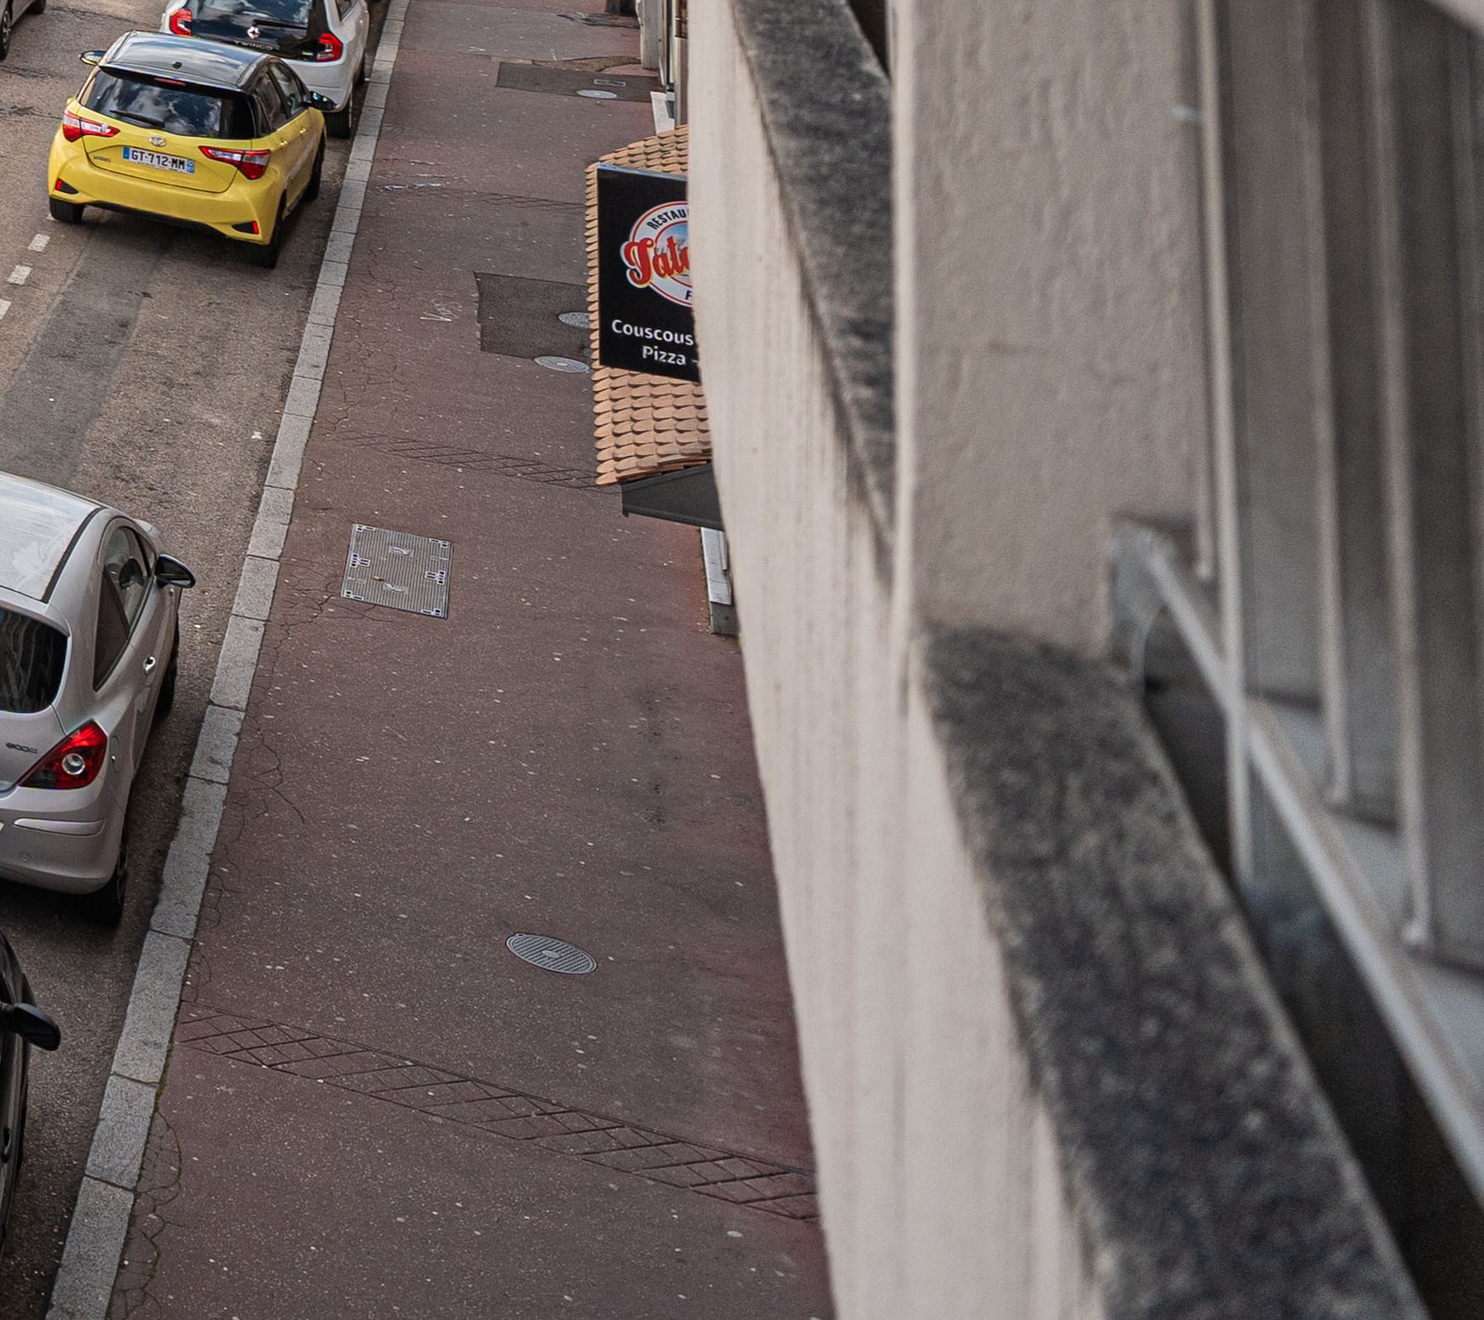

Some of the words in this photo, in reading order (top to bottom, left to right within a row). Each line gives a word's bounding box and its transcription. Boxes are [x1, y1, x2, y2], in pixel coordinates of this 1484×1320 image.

[646, 208, 689, 230] RESTAU
[612, 318, 694, 347] Couscous
[641, 345, 687, 366] Pizza
